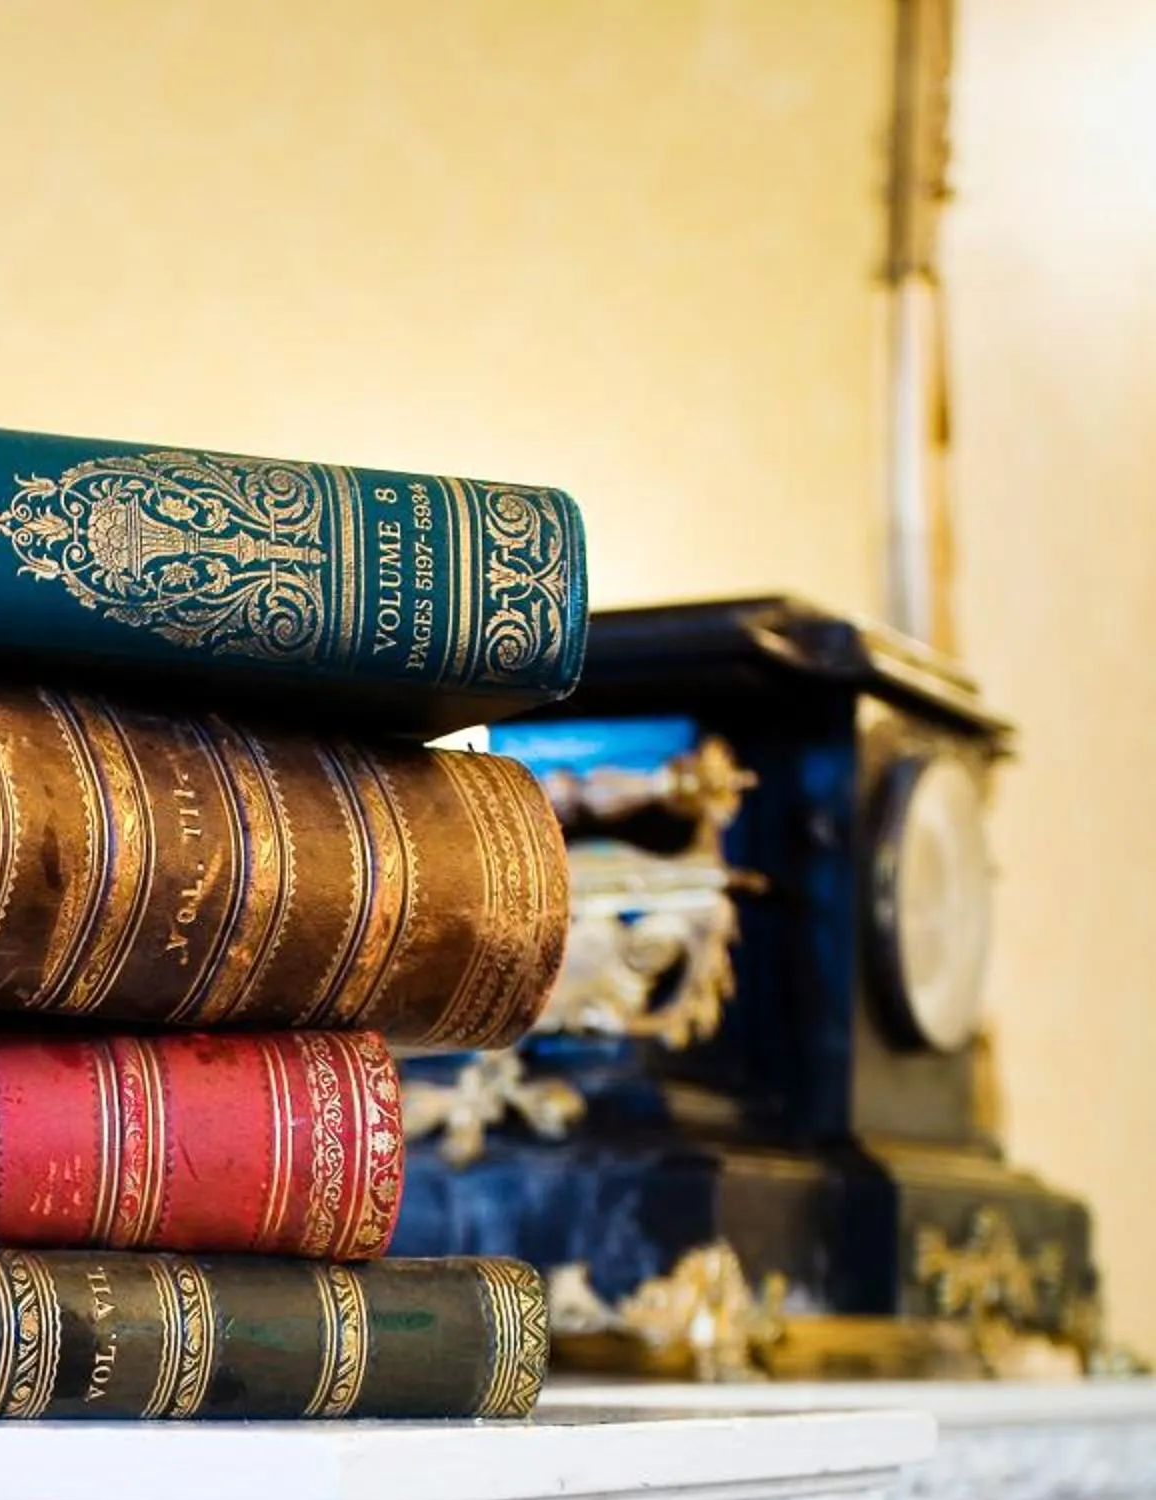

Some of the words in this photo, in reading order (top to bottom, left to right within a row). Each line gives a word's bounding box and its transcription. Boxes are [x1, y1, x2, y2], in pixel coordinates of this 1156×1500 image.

[375, 487, 397, 504] 8
[373, 520, 402, 656] VOLUME
[405, 598, 434, 670] PAGES
[165, 862, 205, 951] VOL.
[87, 1265, 116, 1320] VII.
[83, 1333, 117, 1403] VOL.
